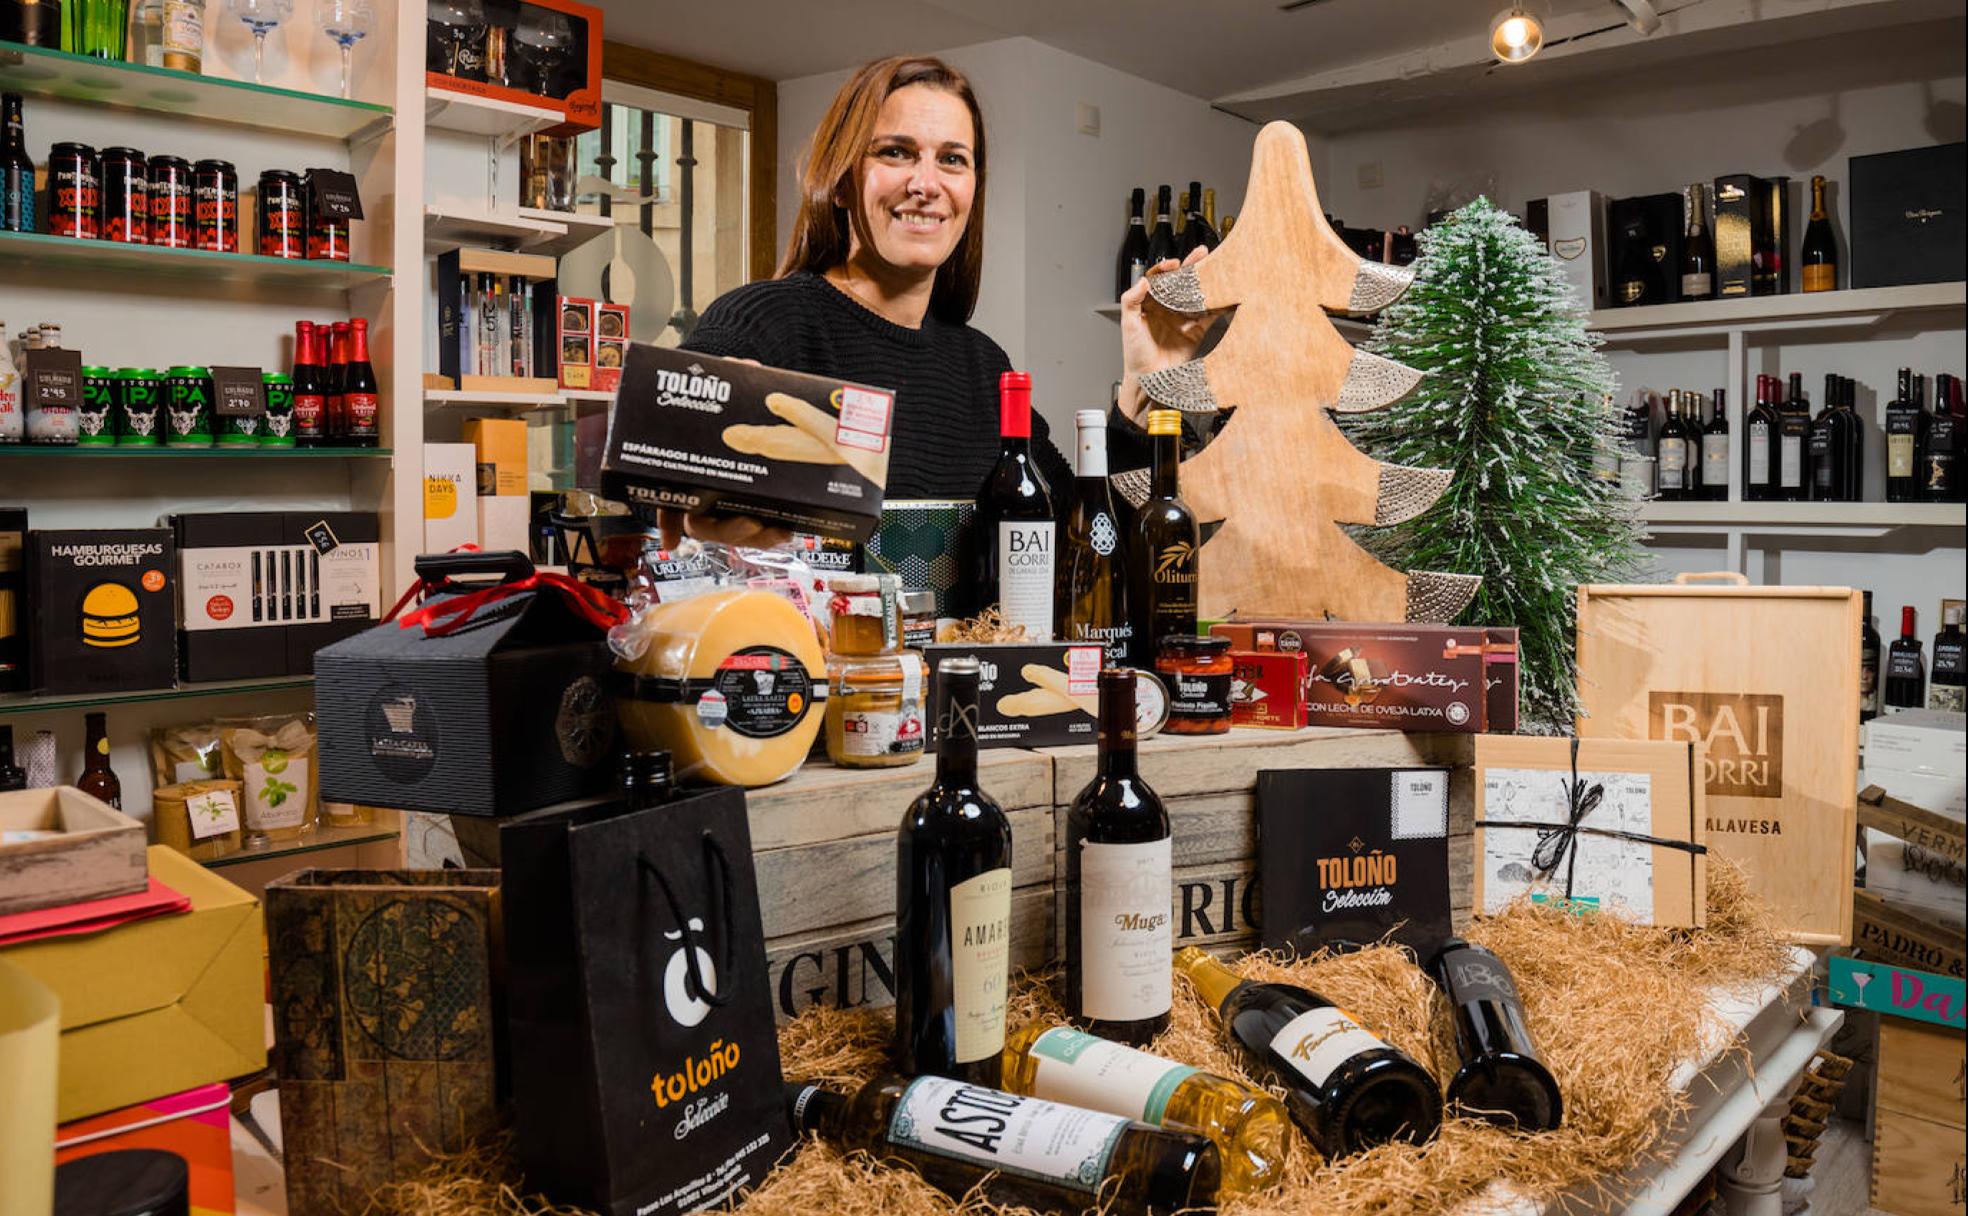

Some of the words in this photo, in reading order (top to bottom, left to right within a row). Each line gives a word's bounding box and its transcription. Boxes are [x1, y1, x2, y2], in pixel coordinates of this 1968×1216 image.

[656, 369, 731, 402] TOLOÑO
[656, 391, 723, 414] Selección
[620, 452, 662, 467] PRODUCTO
[663, 459, 705, 475] CULTIVADO
[718, 470, 754, 483] NAVARRA
[622, 441, 688, 463] ESPÁRRAGOS
[689, 453, 736, 470] BLANCOS
[736, 462, 768, 476] EXTRA
[429, 474, 461, 482] NIKKA
[429, 484, 454, 493] DAYS
[626, 485, 700, 506] TOLOÑO
[51, 543, 163, 557] HAMBURGUESAS
[1010, 530, 1049, 552] BAI
[73, 554, 141, 566] GOURMET
[197, 562, 242, 571] CATABOX
[1008, 553, 1049, 567] GORRI
[1075, 621, 1133, 644] Marqués
[1307, 702, 1327, 712] CON
[1328, 702, 1358, 713] LECHE
[1360, 704, 1375, 713] DE
[1375, 706, 1409, 715] OVEJA
[1410, 707, 1444, 717] LATXA
[1662, 703, 1770, 757] BAI
[1705, 759, 1769, 787] ORRI
[1705, 816, 1782, 835] ALAVESA
[1316, 850, 1397, 889] TOLOÑO
[1322, 887, 1394, 913] Selección
[1114, 912, 1168, 932] Muga
[651, 1038, 741, 1109] toloño
